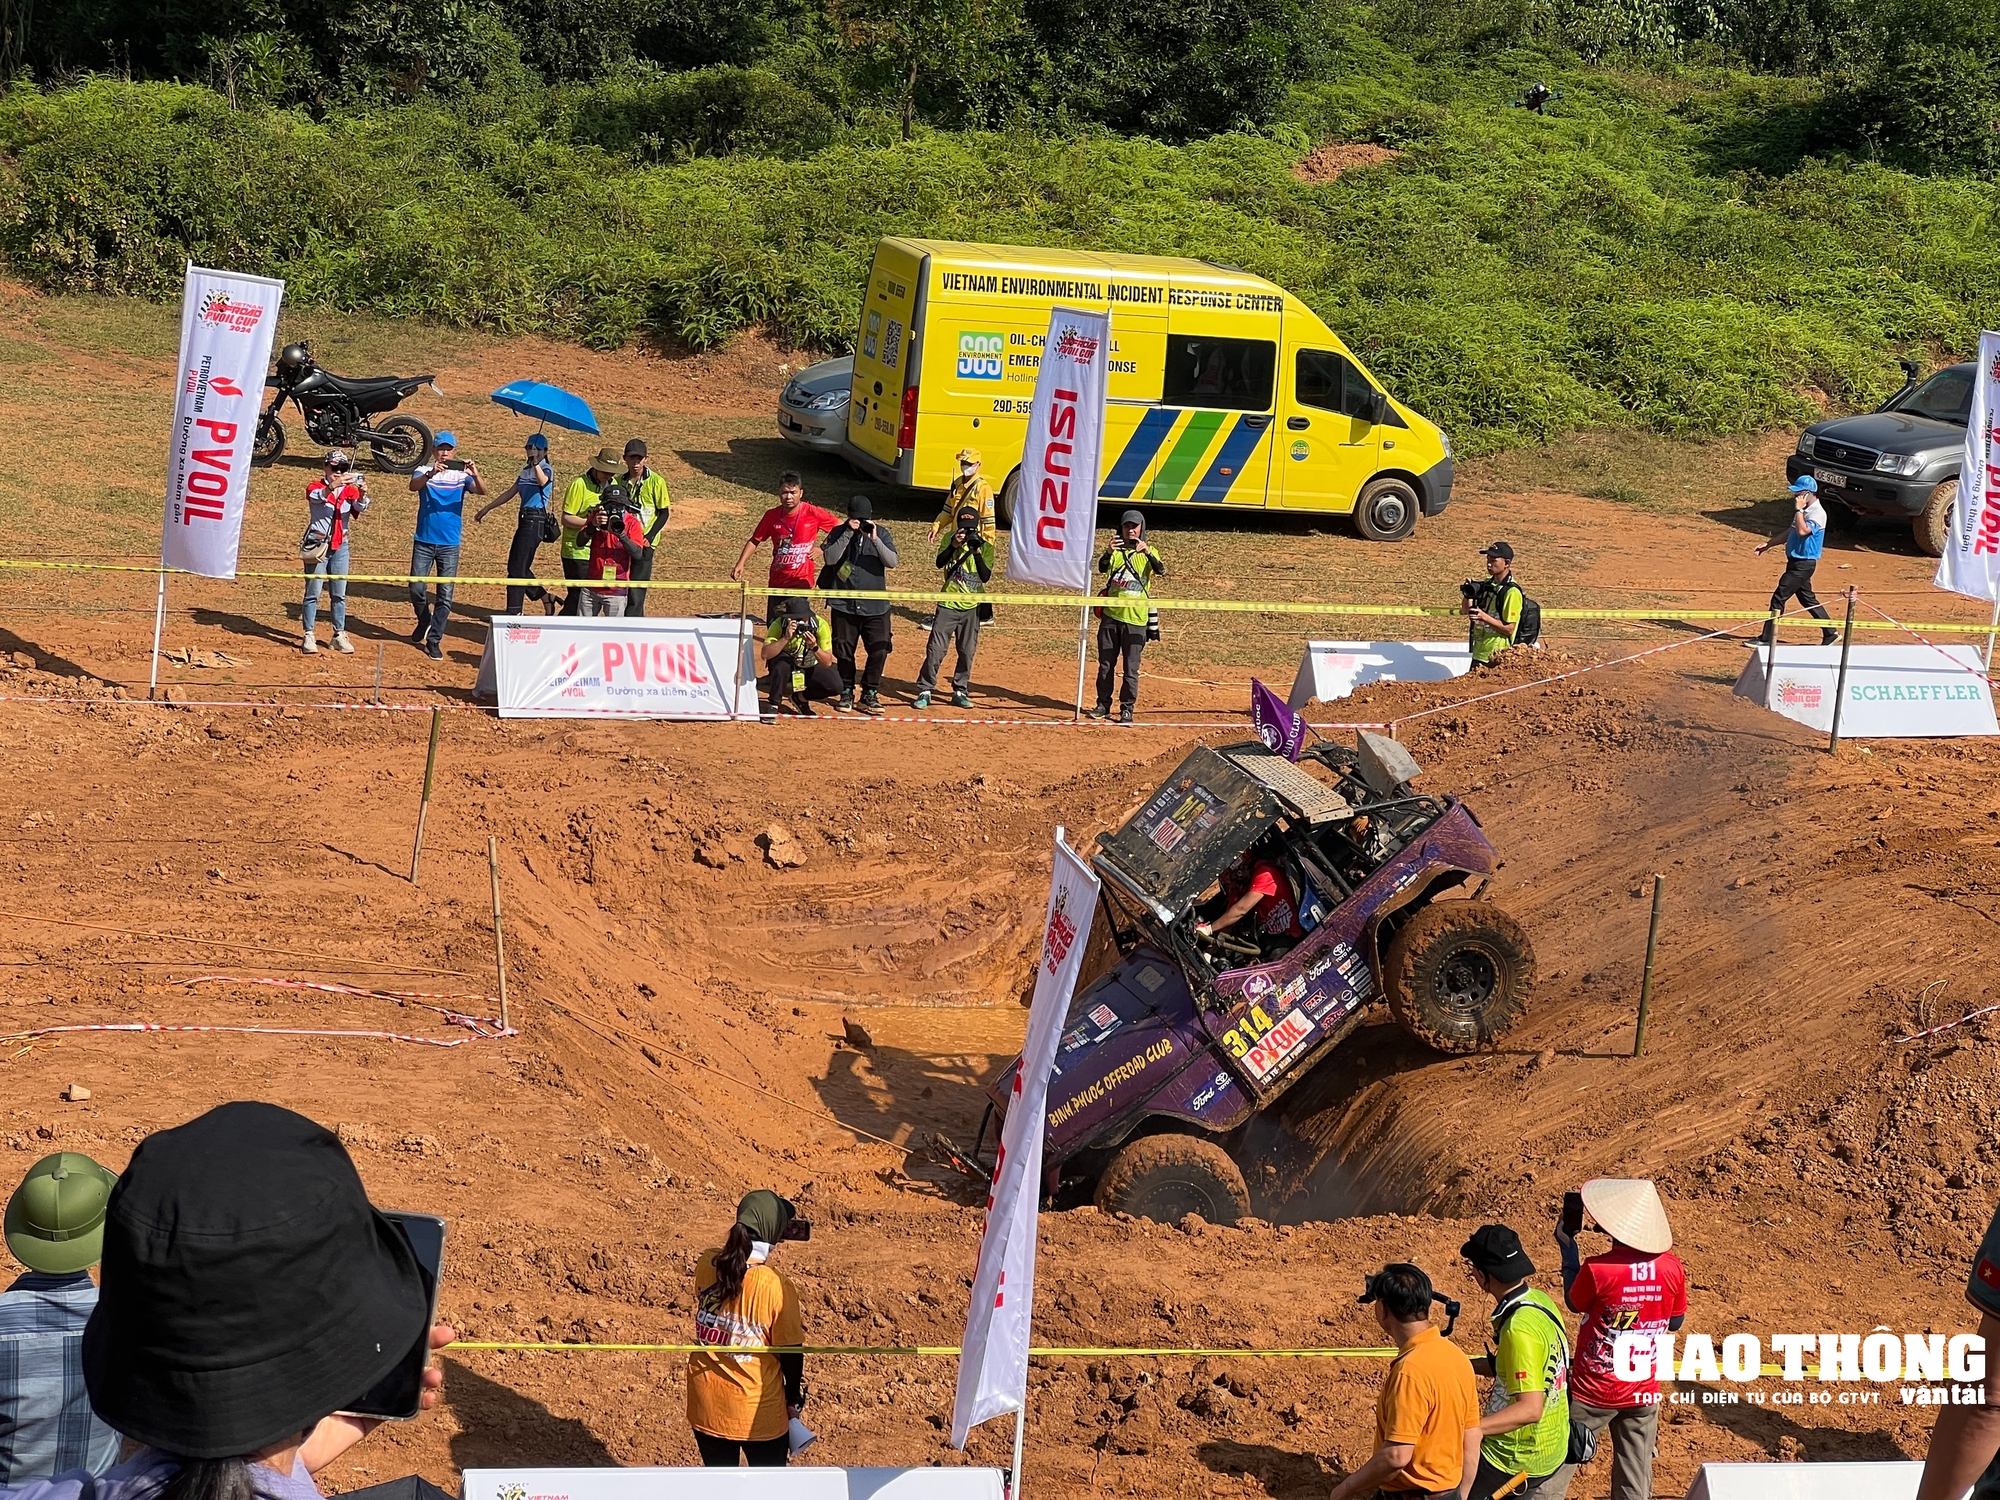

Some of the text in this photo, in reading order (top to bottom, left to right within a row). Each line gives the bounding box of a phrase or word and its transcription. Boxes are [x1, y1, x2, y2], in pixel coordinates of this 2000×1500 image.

[943, 273, 1283, 313] VIETNAM ENVIRONMENTAL INCIDENT RESPONSE CENTER
[230, 301, 263, 310] VIETNAM
[205, 311, 258, 327] PVOIL CUP
[229, 325, 251, 333] 2024
[1010, 333, 1045, 346] OIL-CH
[958, 351, 1002, 360] ENVIRONMENT
[1009, 355, 1136, 373] EMER ONSE
[1079, 349, 1095, 359] CUP
[186, 369, 198, 394] PVOIL
[194, 355, 212, 413] PETROVIETNAM
[179, 417, 192, 454] Đường
[179, 457, 185, 470] xa
[184, 418, 238, 526] PVOIL
[1036, 388, 1078, 551] ISUZU
[176, 473, 185, 500] thêm
[1971, 495, 1979, 506] xa
[602, 642, 708, 683] PVOIL
[562, 687, 586, 697] PVOIL
[607, 686, 643, 697] Đường
[646, 688, 658, 696] xa
[661, 686, 687, 697] thêm
[1851, 685, 1981, 701] SCHAEFFLER
[1289, 712, 1301, 738] CLUB
[1309, 958, 1332, 981] Ford
[1222, 1005, 1274, 1058] 314
[1249, 1019, 1308, 1073] PVOIL
[1048, 1038, 1173, 1128] BINH PHUOC OFFROAD CLUB
[1193, 1087, 1215, 1111] Ford
[1630, 1261, 1656, 1281] 131
[1612, 1311, 1639, 1329] 17
